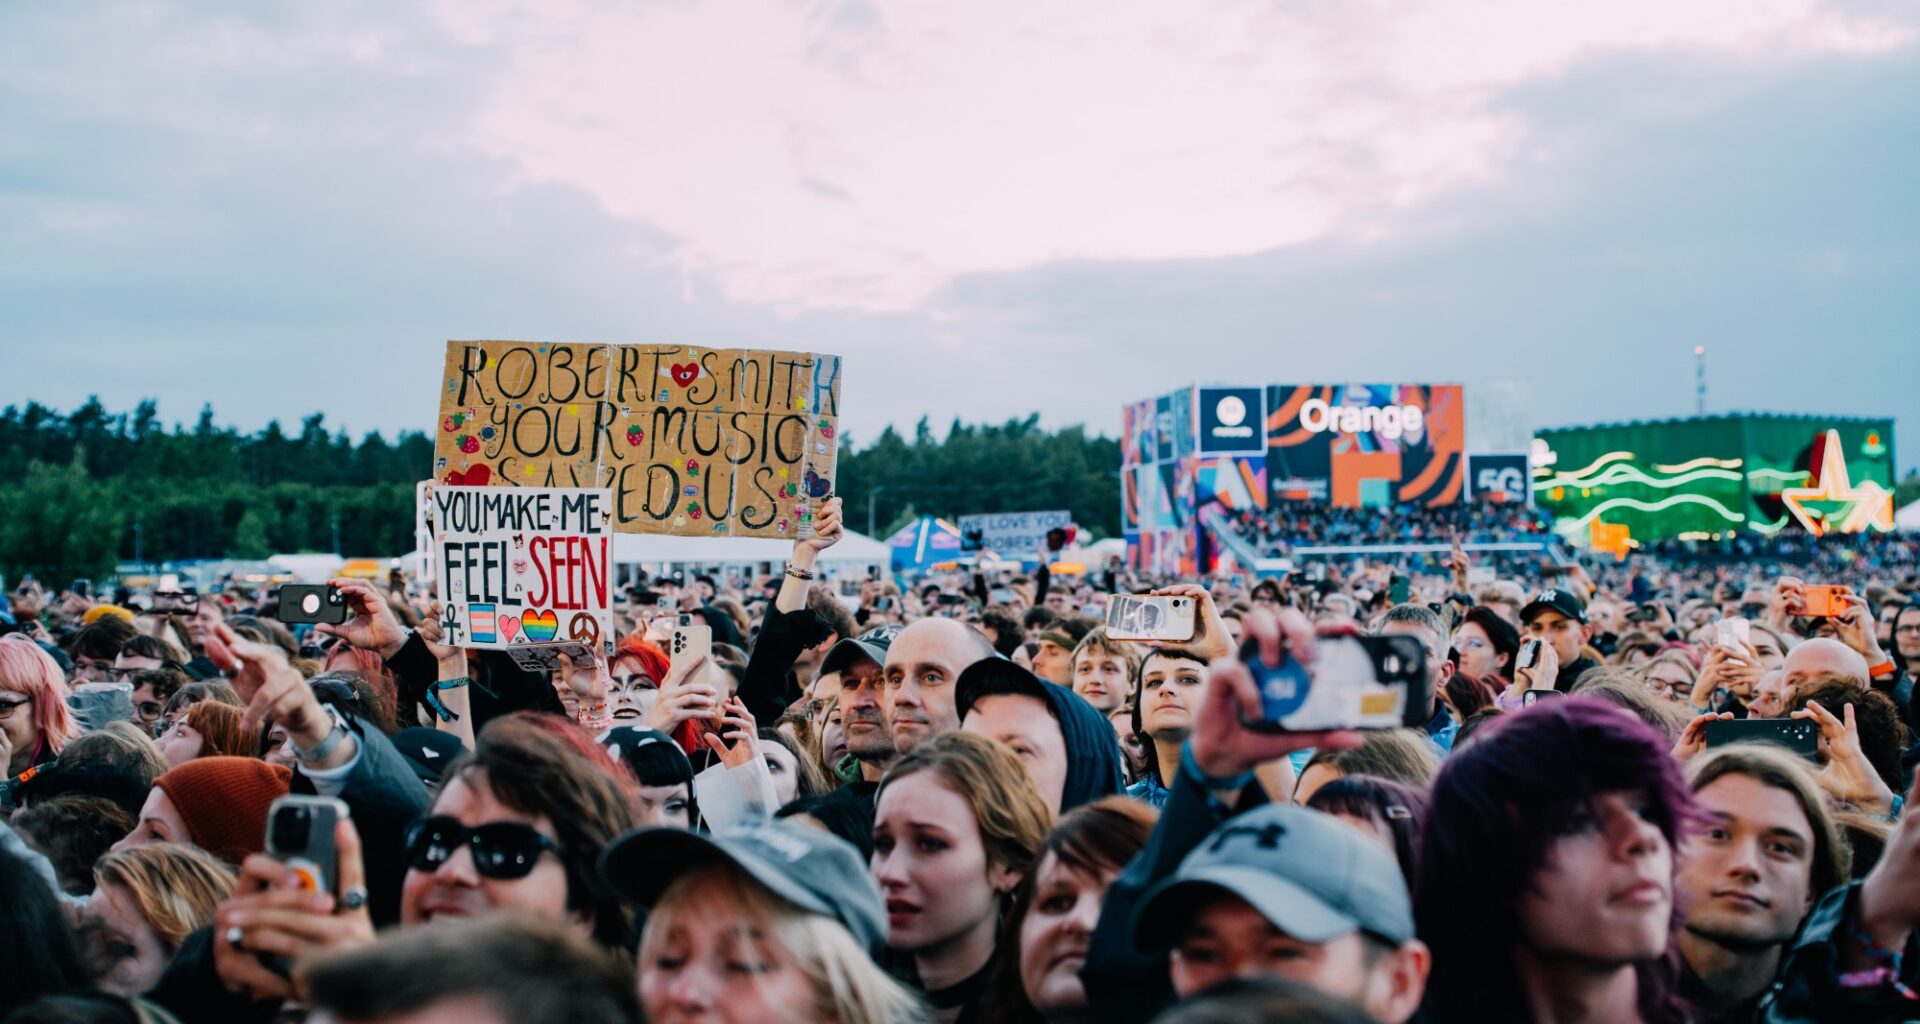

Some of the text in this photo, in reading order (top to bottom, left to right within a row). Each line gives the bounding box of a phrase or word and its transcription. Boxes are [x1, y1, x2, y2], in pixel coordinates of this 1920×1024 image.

[457, 344, 839, 417] ROBERT SMITH
[484, 399, 809, 465] YOUR MUSIC
[1299, 398, 1423, 440] Orange
[703, 463, 778, 530] US
[1478, 466, 1524, 493] 5G
[435, 491, 601, 534] YOU MAKE ME
[988, 514, 1029, 531] LOVE
[1034, 511, 1069, 528] YOU
[444, 536, 608, 610] FEEL SEEN
